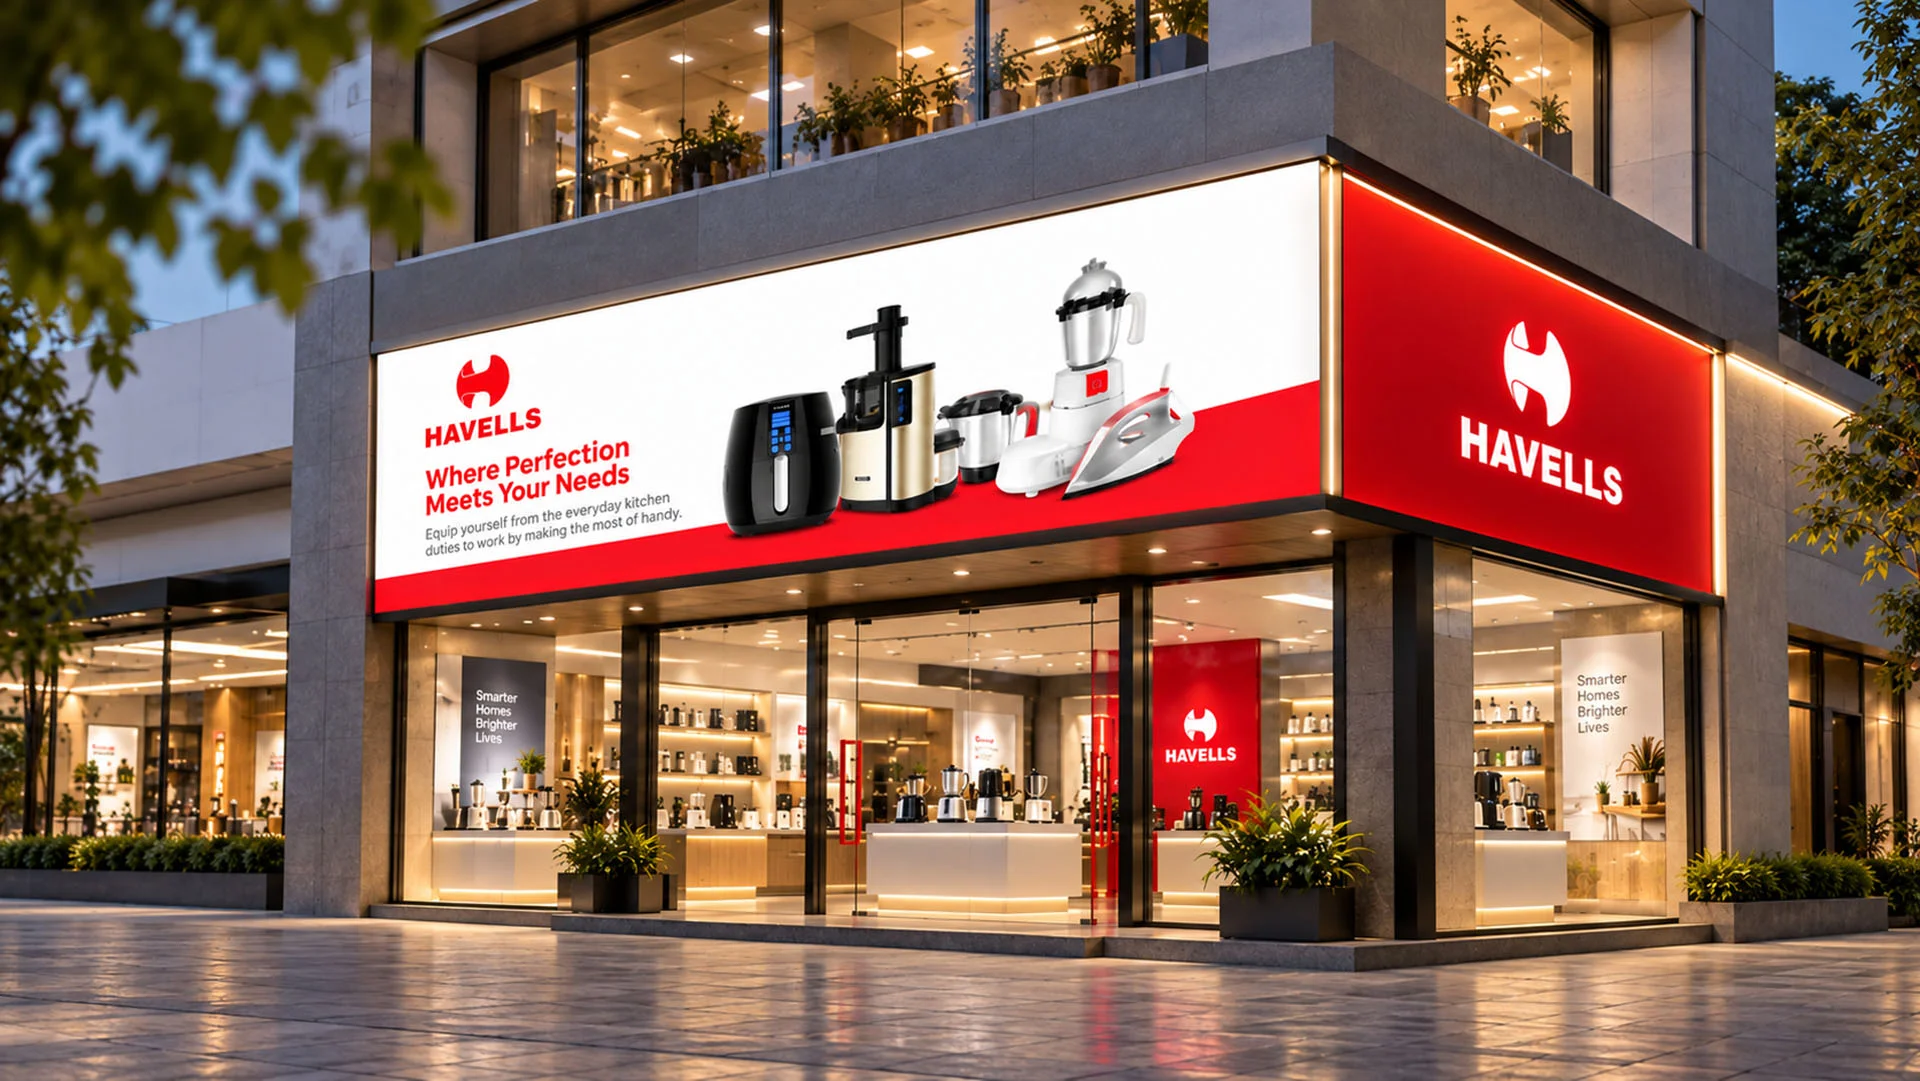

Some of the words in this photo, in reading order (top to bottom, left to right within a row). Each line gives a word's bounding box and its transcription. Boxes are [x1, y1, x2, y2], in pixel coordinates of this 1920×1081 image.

[425, 407, 542, 448] HAVELLS
[425, 463, 500, 490] Where
[505, 440, 630, 477] Perfection
[1460, 415, 1623, 505] HAVELLS
[425, 488, 494, 516] Meets
[498, 480, 550, 503] Your
[556, 463, 630, 495] Needs
[425, 525, 458, 541] Equip
[460, 515, 508, 537] yourself
[511, 514, 539, 527] from
[542, 509, 562, 522] the
[565, 500, 622, 517] everyday
[624, 493, 670, 509] kitchen
[425, 543, 460, 557] duties
[463, 541, 474, 551] to
[477, 534, 505, 549] work
[508, 532, 522, 546] by
[525, 526, 567, 542] making
[570, 522, 590, 535] the
[592, 517, 622, 531] most
[625, 512, 638, 526] of
[641, 507, 682, 524] handy.
[1577, 673, 1627, 687] Smarter
[476, 689, 518, 704] Smarter
[1577, 690, 1620, 702] Homes
[475, 703, 512, 717] Homes
[1577, 704, 1628, 720] Brighter
[475, 717, 518, 732] Brighter
[1578, 721, 1610, 734] Lives
[475, 731, 502, 744] Lives
[1165, 746, 1237, 763] HAVELLS
